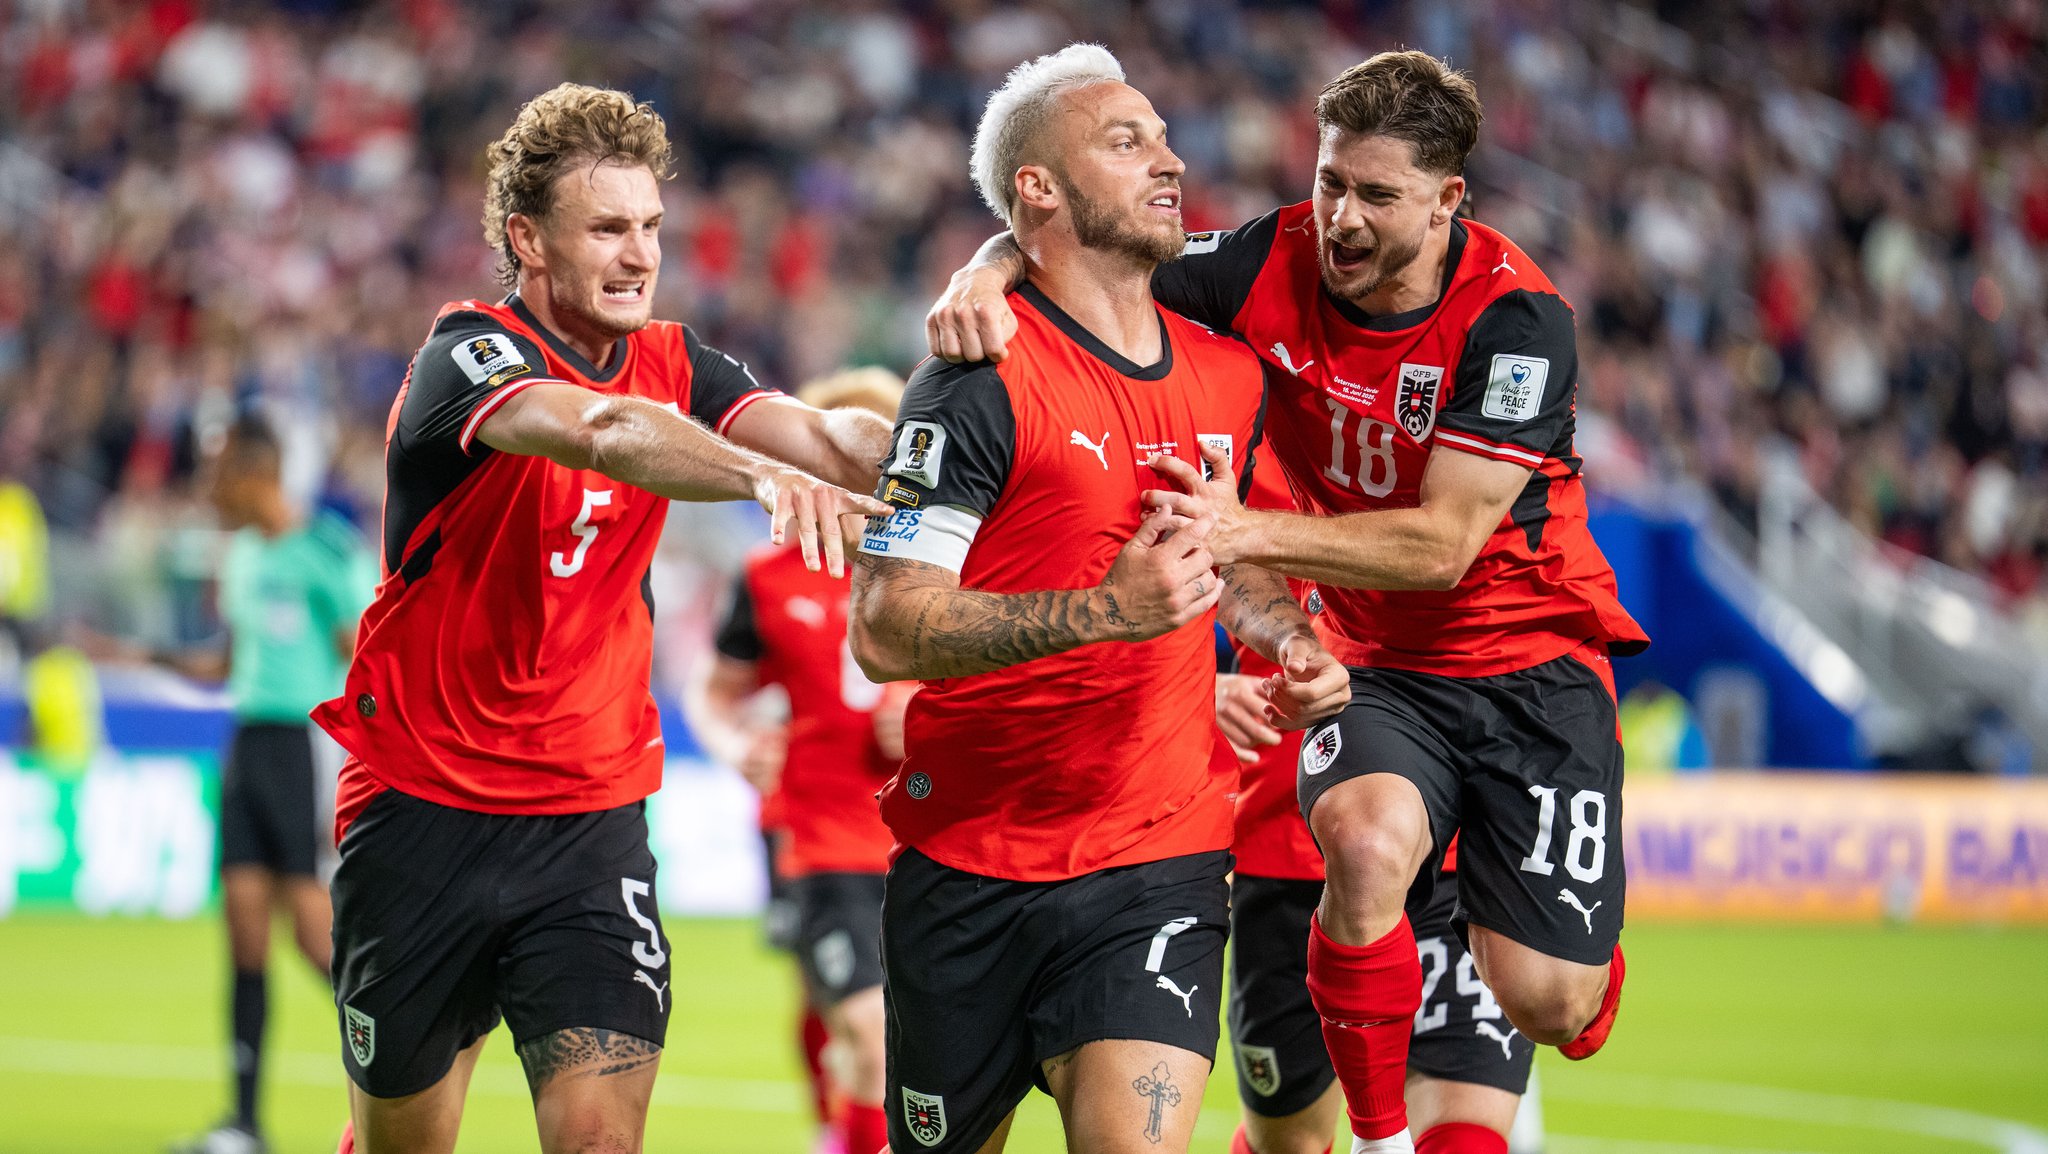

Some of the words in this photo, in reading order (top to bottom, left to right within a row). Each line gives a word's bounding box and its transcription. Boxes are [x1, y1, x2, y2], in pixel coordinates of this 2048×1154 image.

[1500, 394, 1527, 409] PEACE
[1501, 382, 1520, 395] Unite
[1521, 386, 1531, 397] For
[1504, 407, 1519, 416] FIFA
[1323, 397, 1398, 498] 18
[894, 489, 917, 500] DEBUT
[549, 487, 614, 578] 5
[866, 540, 886, 551] FIFA
[873, 524, 920, 542] World
[1519, 784, 1607, 884] 18
[621, 877, 666, 970] 5
[1144, 916, 1198, 973] 7
[1413, 936, 1502, 1036] 24
